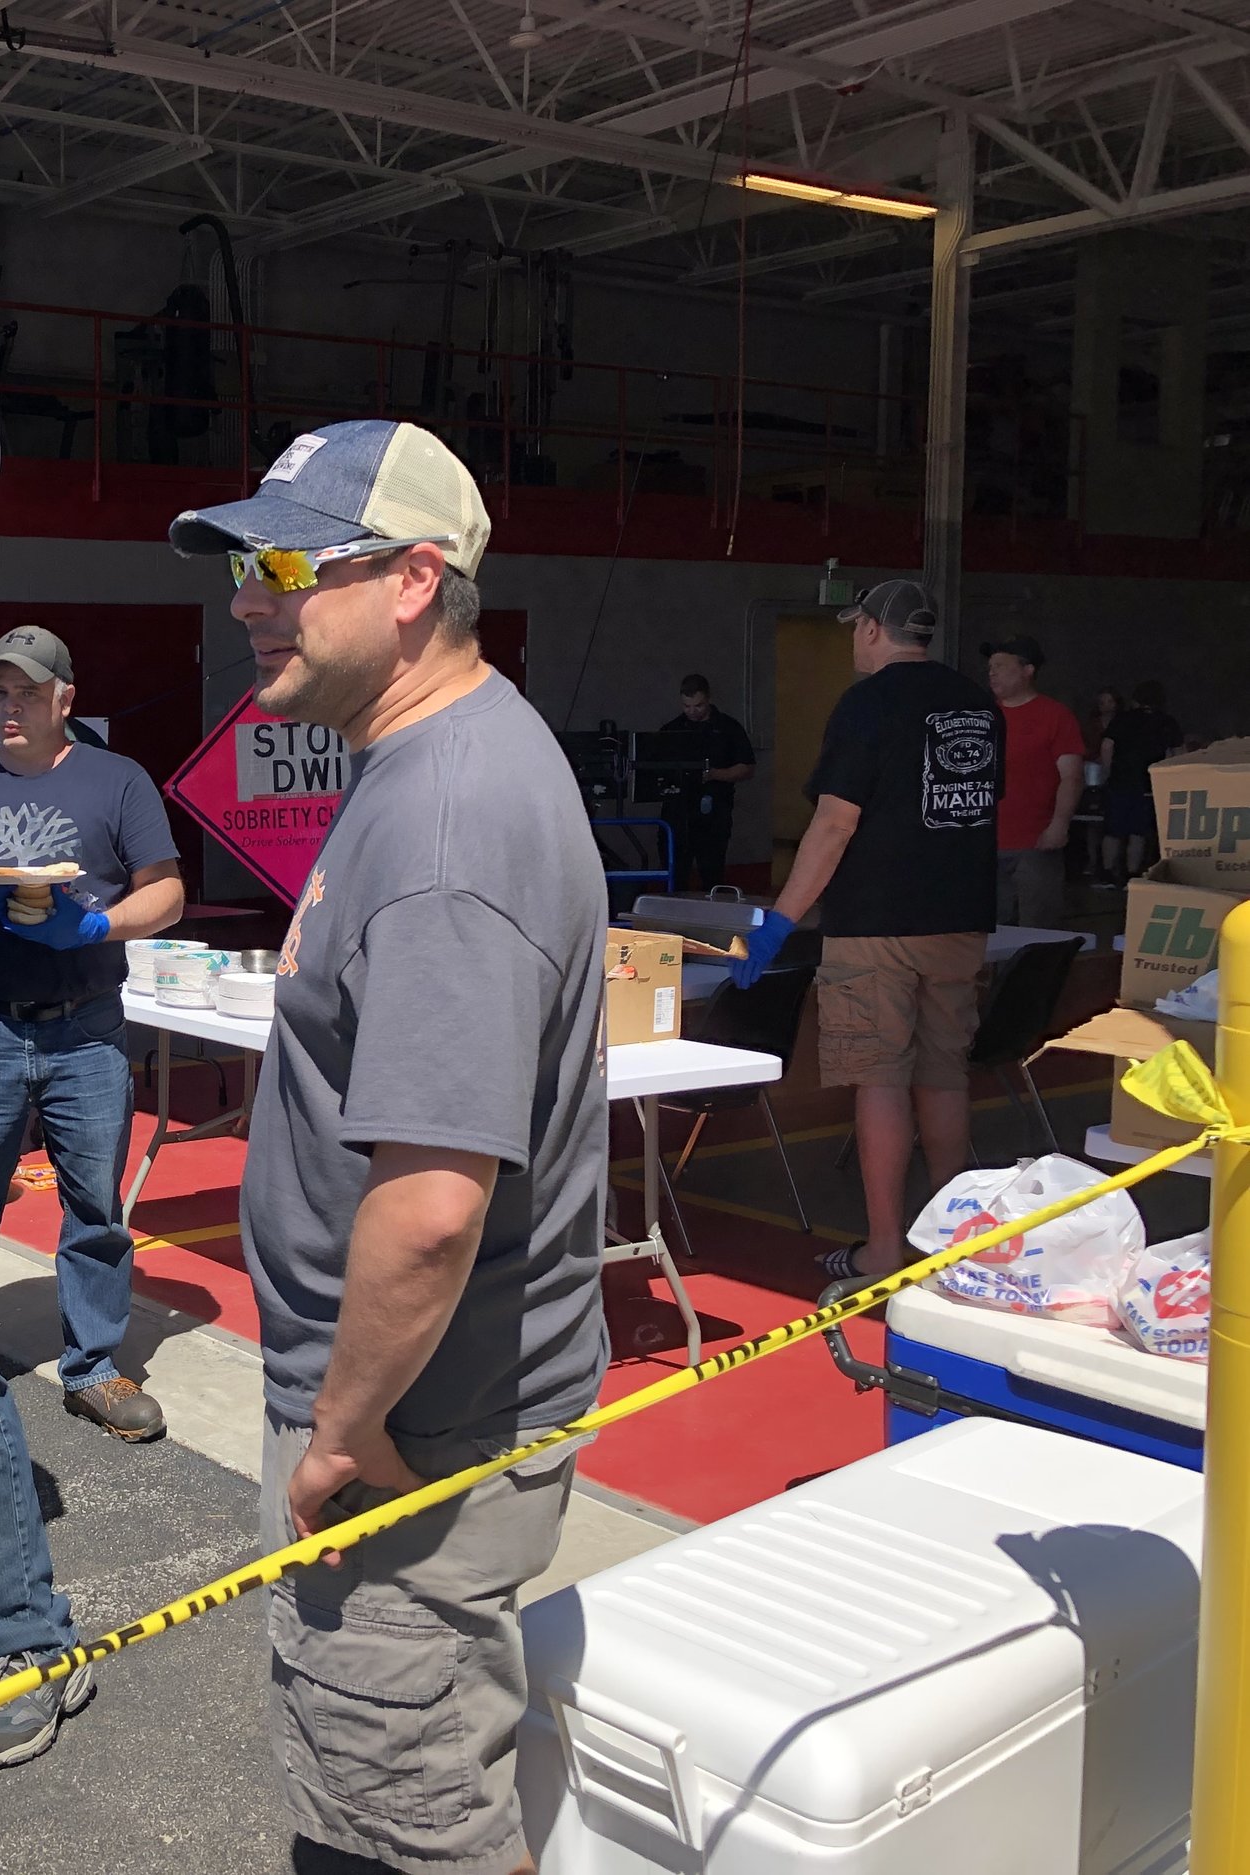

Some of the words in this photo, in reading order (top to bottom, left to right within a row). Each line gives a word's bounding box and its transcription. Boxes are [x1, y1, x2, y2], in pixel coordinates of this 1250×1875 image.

[934, 717, 990, 733] ELIZABETHTOWN
[967, 750, 980, 758] 74
[272, 757, 343, 793] DWI
[932, 782, 974, 793] ENGINE
[932, 791, 994, 810] MAKIN
[222, 806, 312, 831] SOBRIETY
[241, 836, 275, 848] Drive
[276, 834, 308, 846] Sober
[310, 836, 321, 845] or
[1164, 847, 1212, 858] Trusted
[1134, 957, 1199, 976] Trusted
